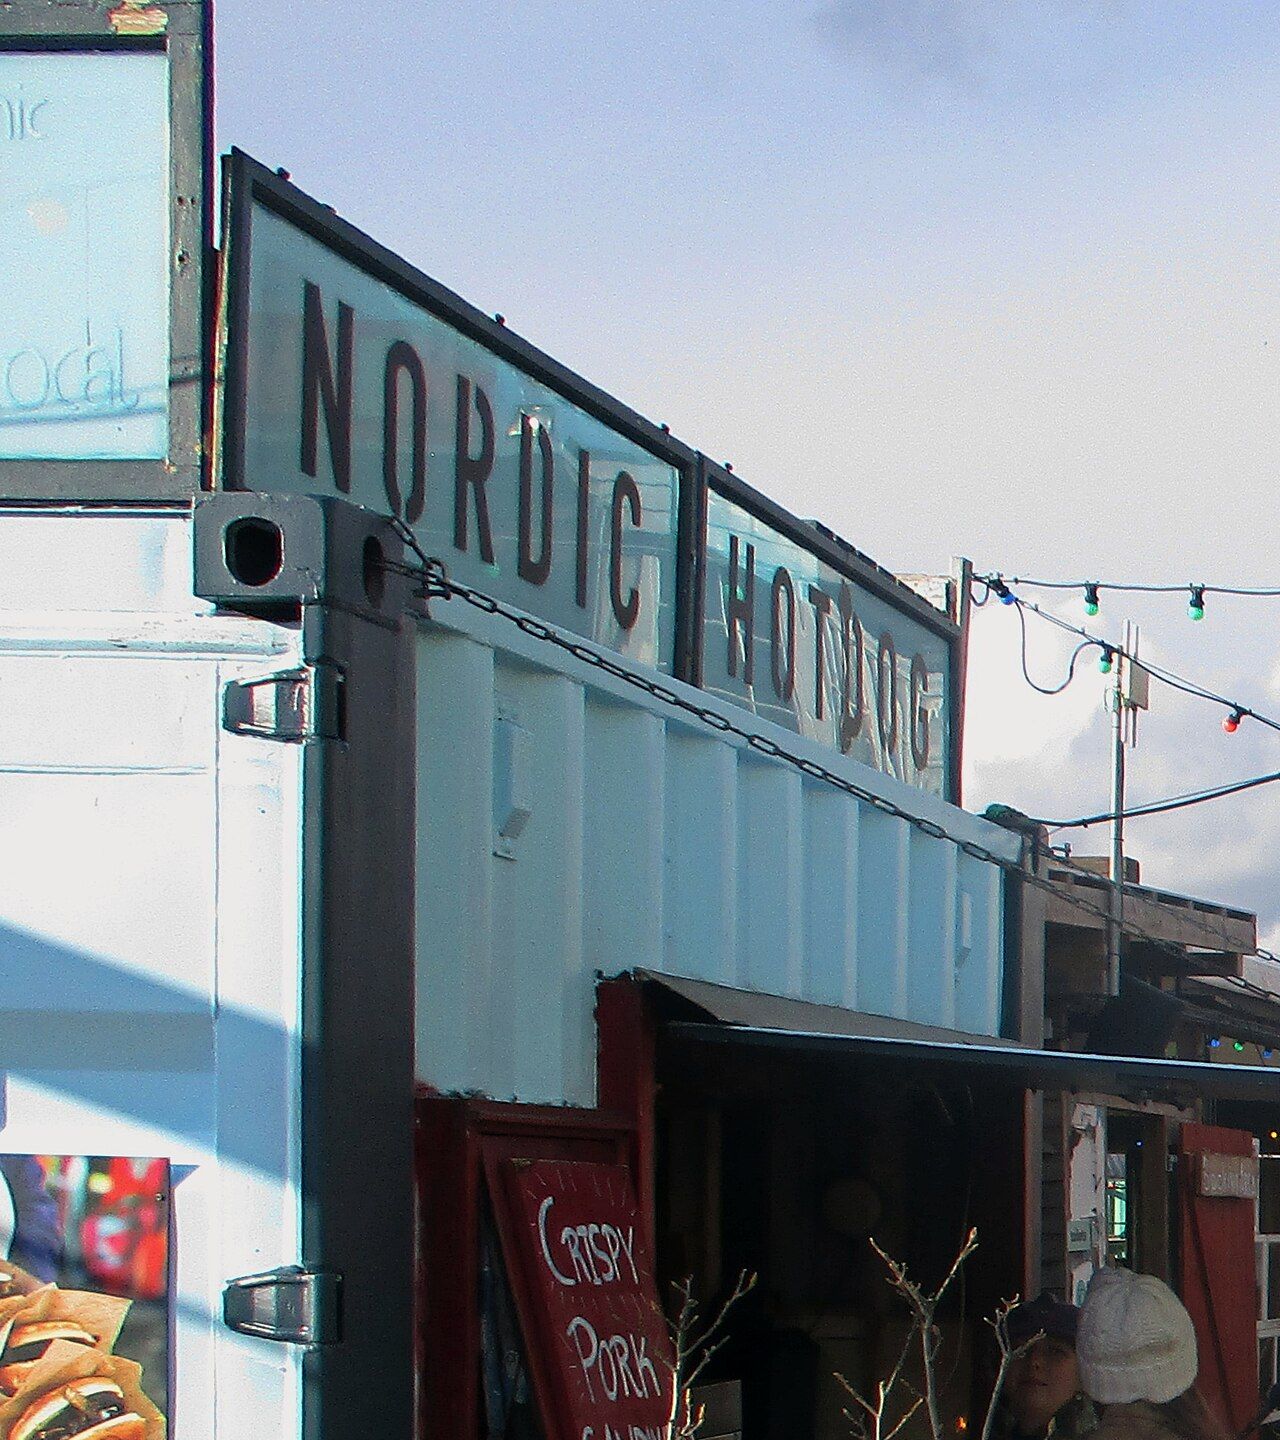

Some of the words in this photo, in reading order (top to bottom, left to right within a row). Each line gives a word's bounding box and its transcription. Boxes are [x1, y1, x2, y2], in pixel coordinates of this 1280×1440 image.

[300, 278, 642, 630] NORDIC
[537, 1195, 641, 1287] CRISPY
[566, 1316, 662, 1403] PORK
